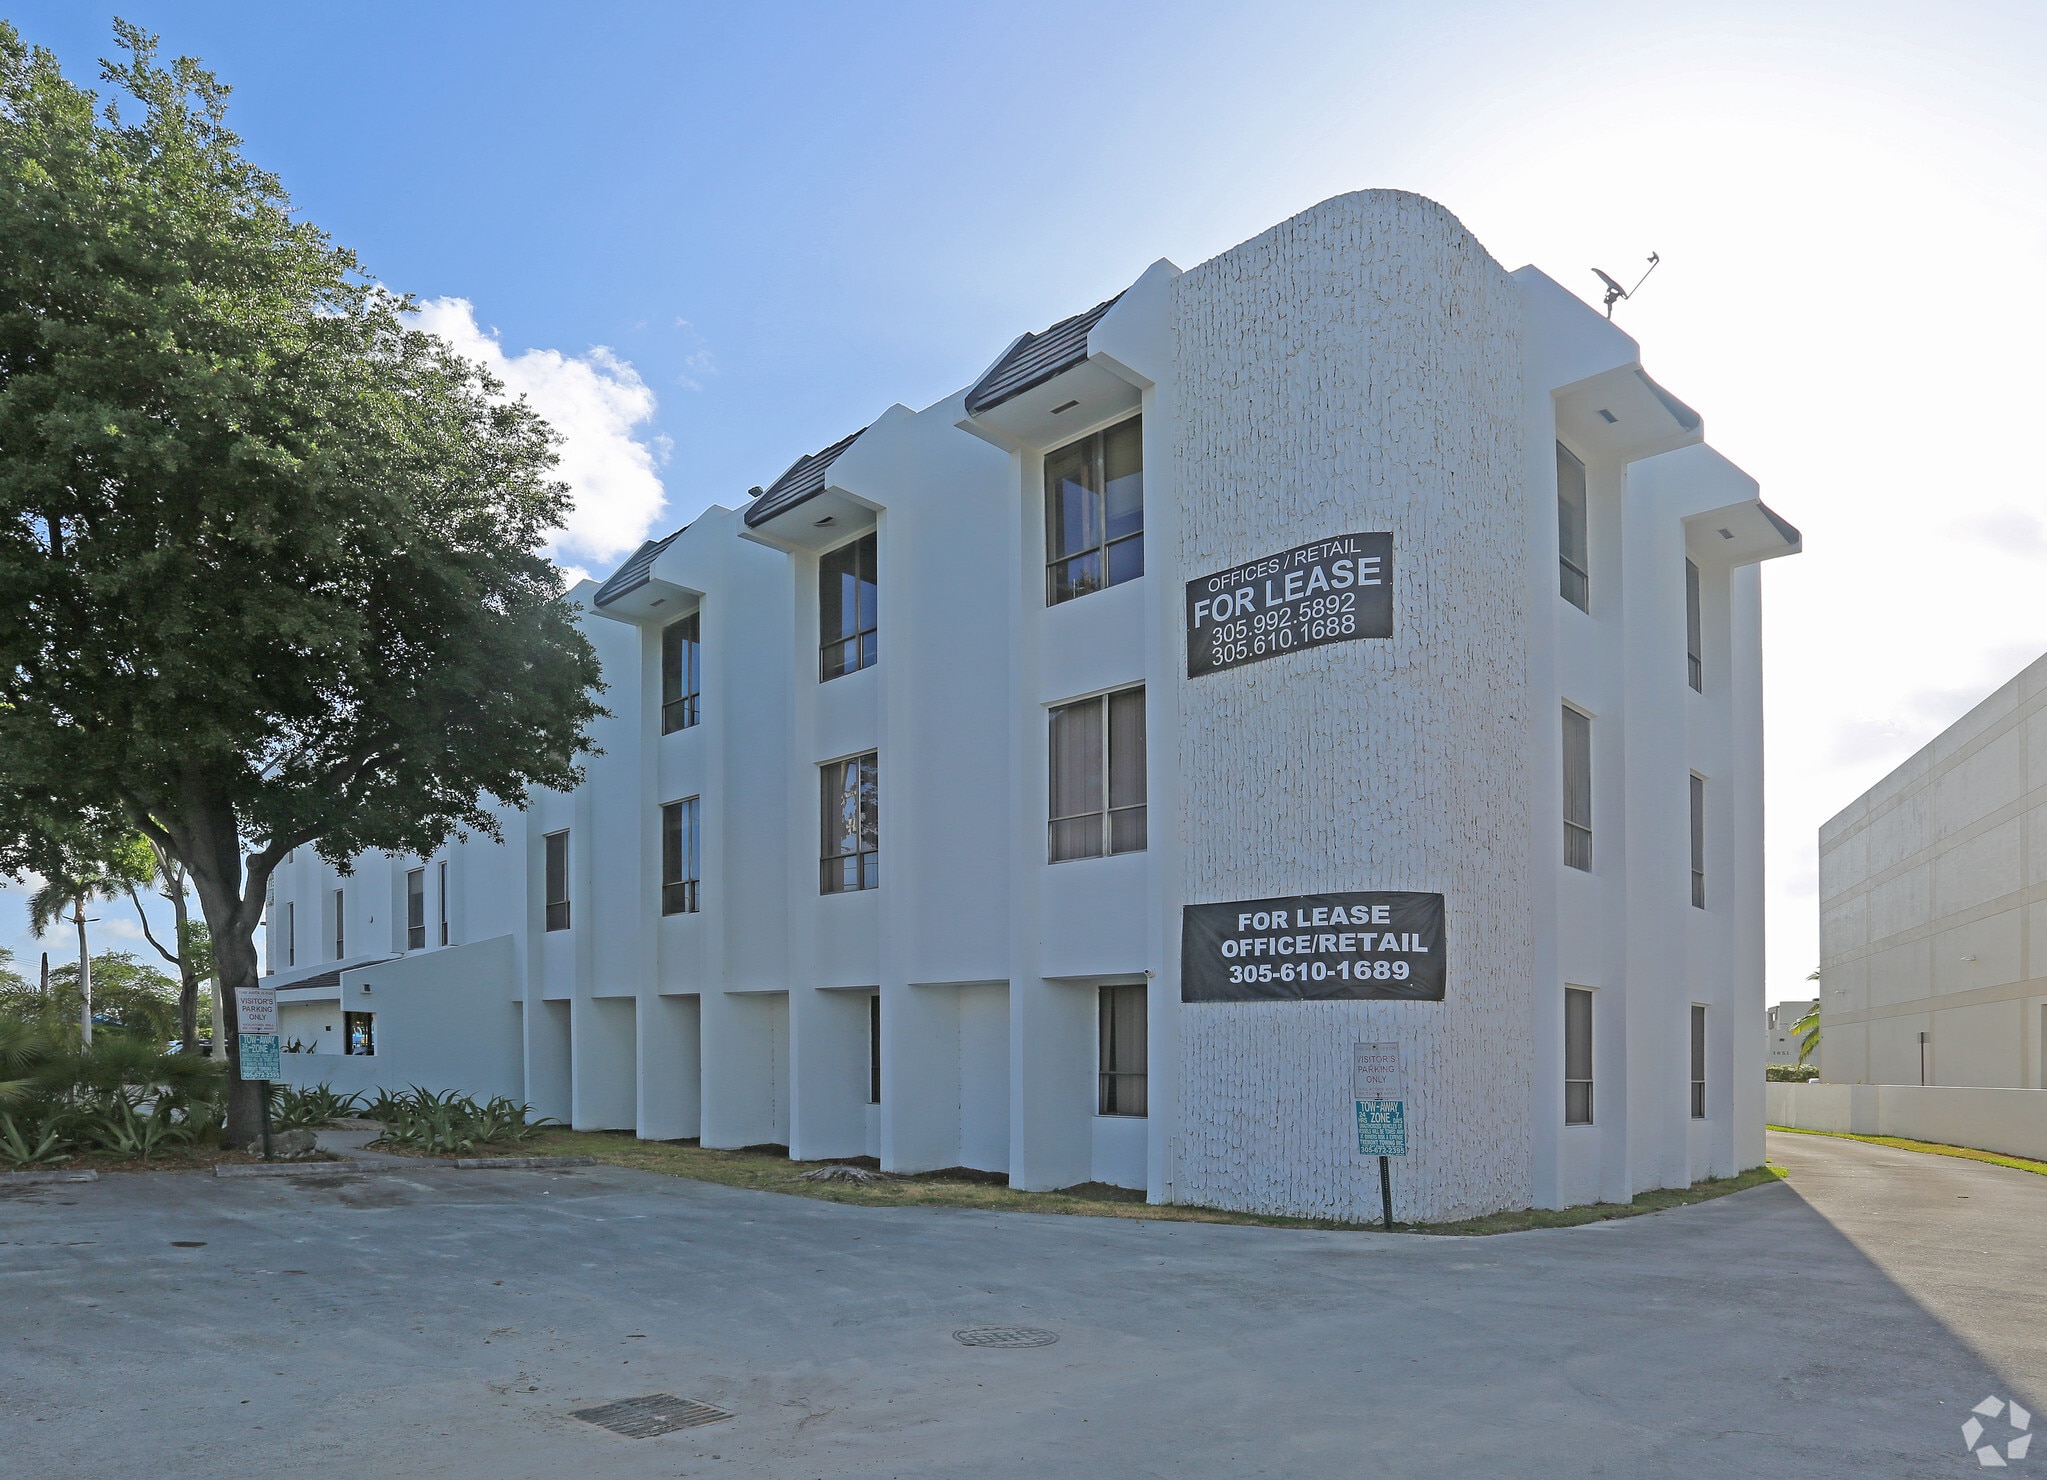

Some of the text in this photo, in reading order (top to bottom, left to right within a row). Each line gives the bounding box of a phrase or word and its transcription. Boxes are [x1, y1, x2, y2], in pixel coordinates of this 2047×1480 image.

[1208, 538, 1362, 592] OFFICES / RETAIL
[1194, 556, 1382, 629] FOR LEASE
[1212, 592, 1356, 646] 305.992.5892
[1212, 614, 1356, 666] 305.610.1688
[1238, 905, 1391, 932] FOR LEASE
[1221, 932, 1428, 958] OFFICE/RETAIL
[1229, 960, 1410, 984] 305-610-1689
[244, 1034, 275, 1044] TOW-AWAY
[252, 1044, 268, 1053] ZONE
[1356, 1055, 1396, 1064] VISITOR'S
[1358, 1066, 1394, 1074] PARKING
[1366, 1076, 1386, 1084] ONLY
[1360, 1102, 1398, 1112] TOW-AWAY
[1370, 1112, 1390, 1123] ZONE
